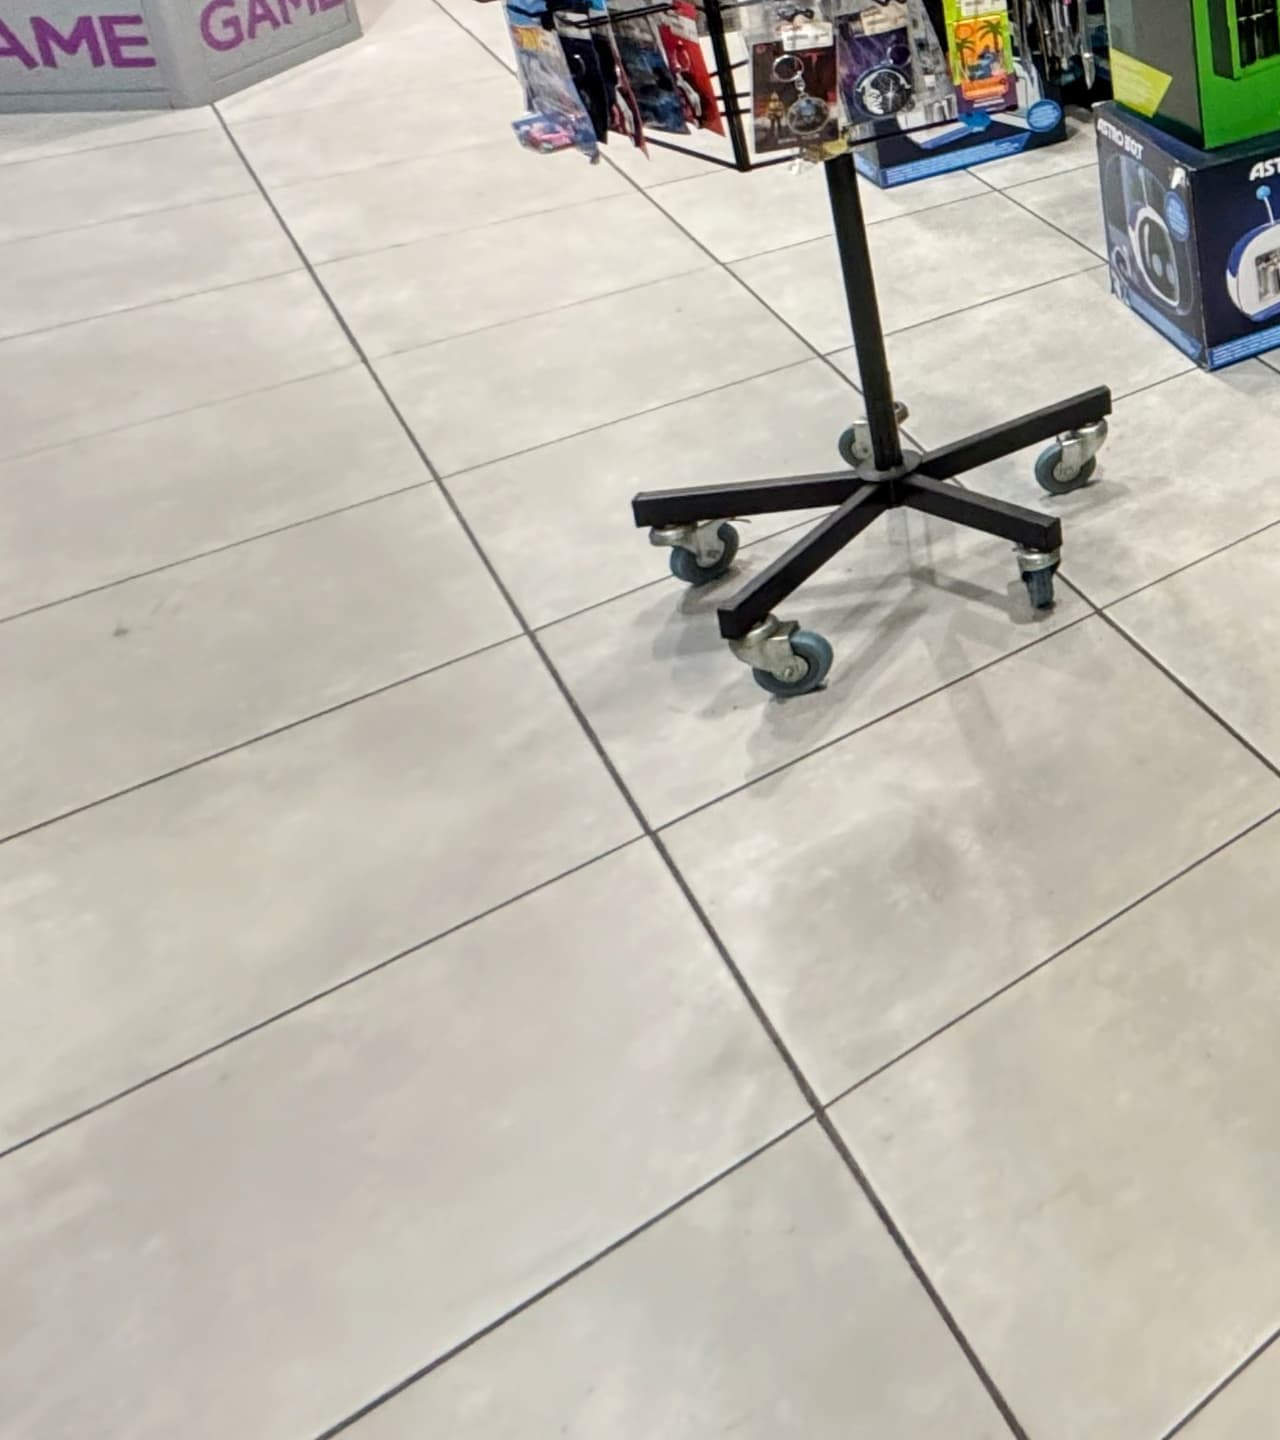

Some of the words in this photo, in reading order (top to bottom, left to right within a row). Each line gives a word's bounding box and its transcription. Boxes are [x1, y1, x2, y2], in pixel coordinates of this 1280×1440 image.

[0, 14, 156, 69] AME
[1097, 119, 1123, 147] ASTRO
[1124, 135, 1144, 158] BOT
